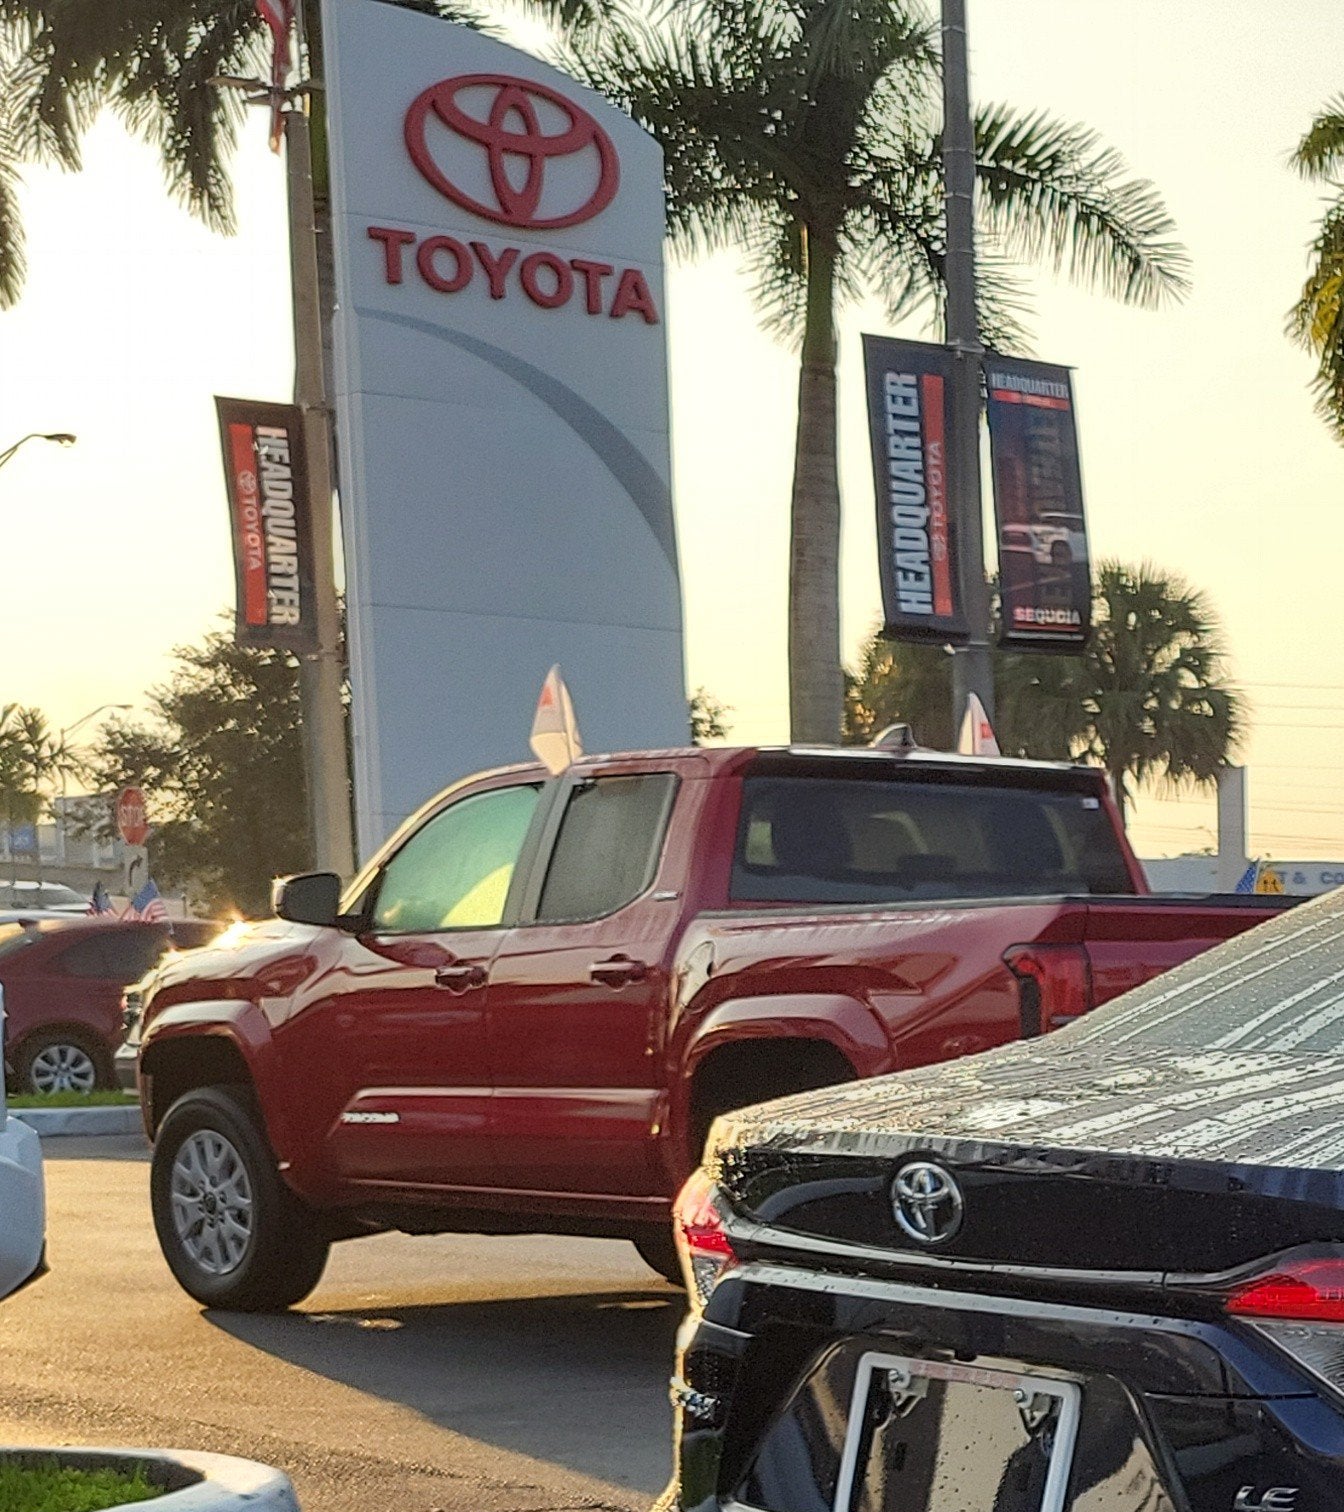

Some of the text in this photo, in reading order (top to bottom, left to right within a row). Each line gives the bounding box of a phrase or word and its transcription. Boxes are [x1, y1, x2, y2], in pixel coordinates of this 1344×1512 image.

[367, 226, 660, 325] TOYOTA
[255, 425, 300, 626] HEADQUARTER
[885, 371, 934, 615] HEADQUARTER
[928, 441, 948, 527] TOYOTA
[240, 497, 263, 571] TOYOTA
[1013, 606, 1081, 625] SEQUOIA
